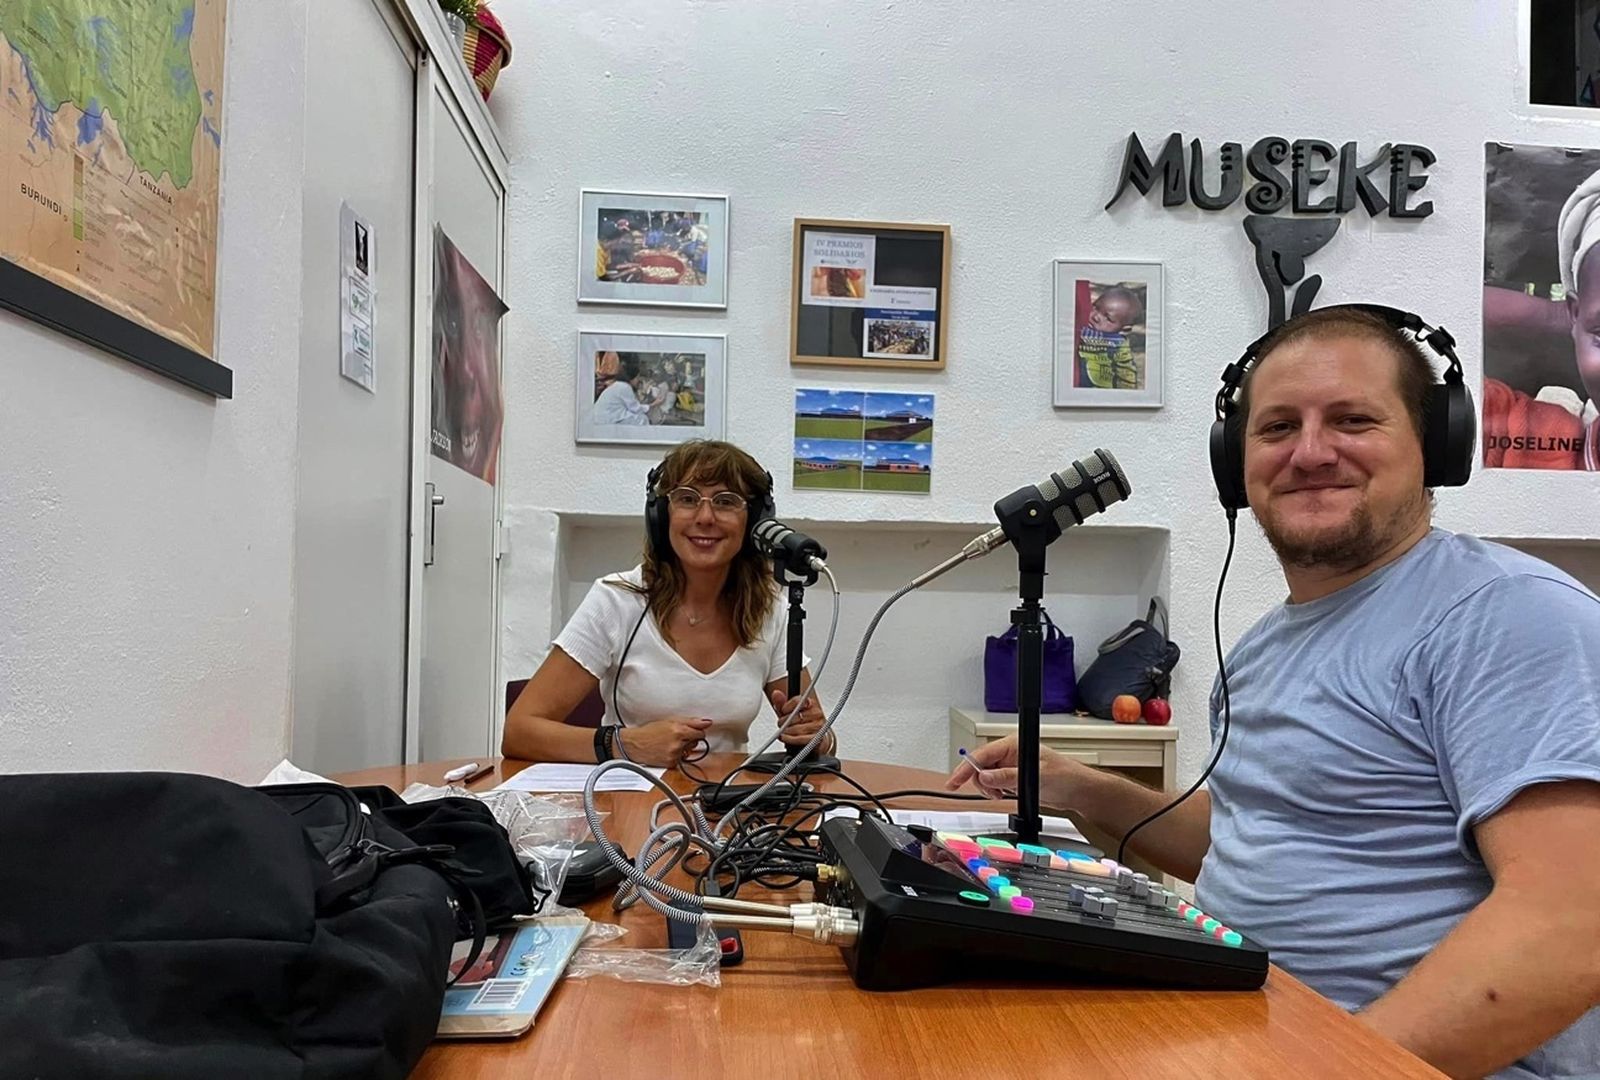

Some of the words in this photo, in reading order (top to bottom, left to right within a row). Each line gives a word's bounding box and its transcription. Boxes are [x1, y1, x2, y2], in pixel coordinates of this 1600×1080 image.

[1104, 131, 1437, 218] MUSEKE
[20, 183, 62, 215] BURUNDI
[139, 175, 173, 206] TANZANIA
[1488, 435, 1583, 452] JOSELINE
